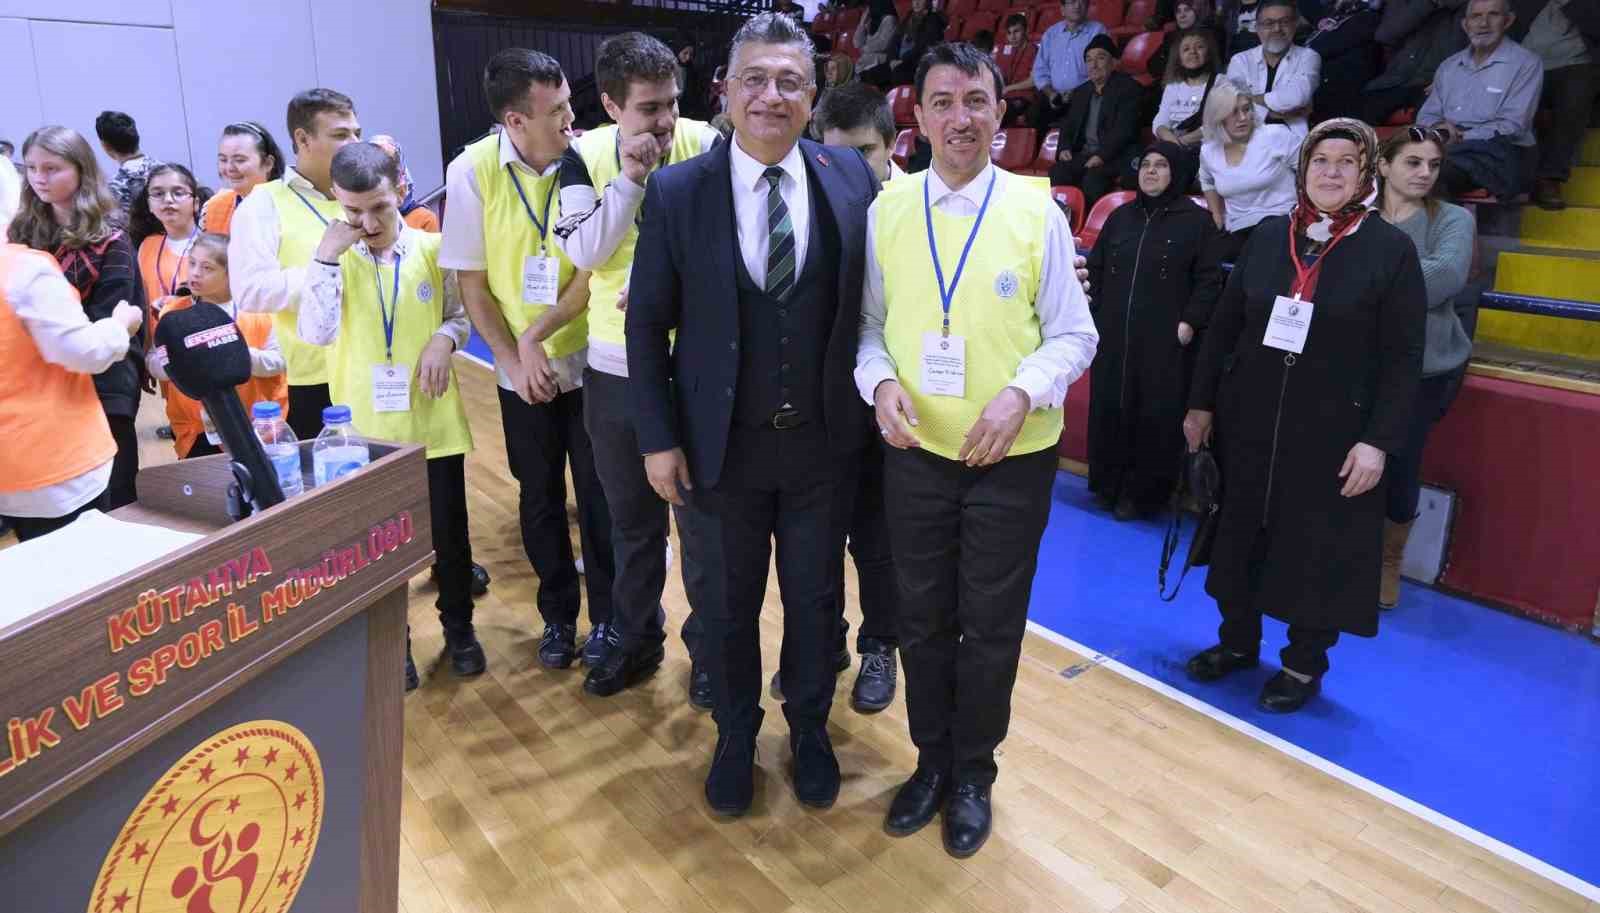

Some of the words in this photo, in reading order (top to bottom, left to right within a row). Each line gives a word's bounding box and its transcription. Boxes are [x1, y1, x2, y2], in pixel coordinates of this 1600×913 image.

[62, 672, 125, 730] VE
[127, 619, 224, 696] SPOR
[227, 602, 259, 643] İL
[260, 511, 415, 624] MÜDÜRLÜĞÜ
[107, 546, 272, 652] KÜTAHYA
